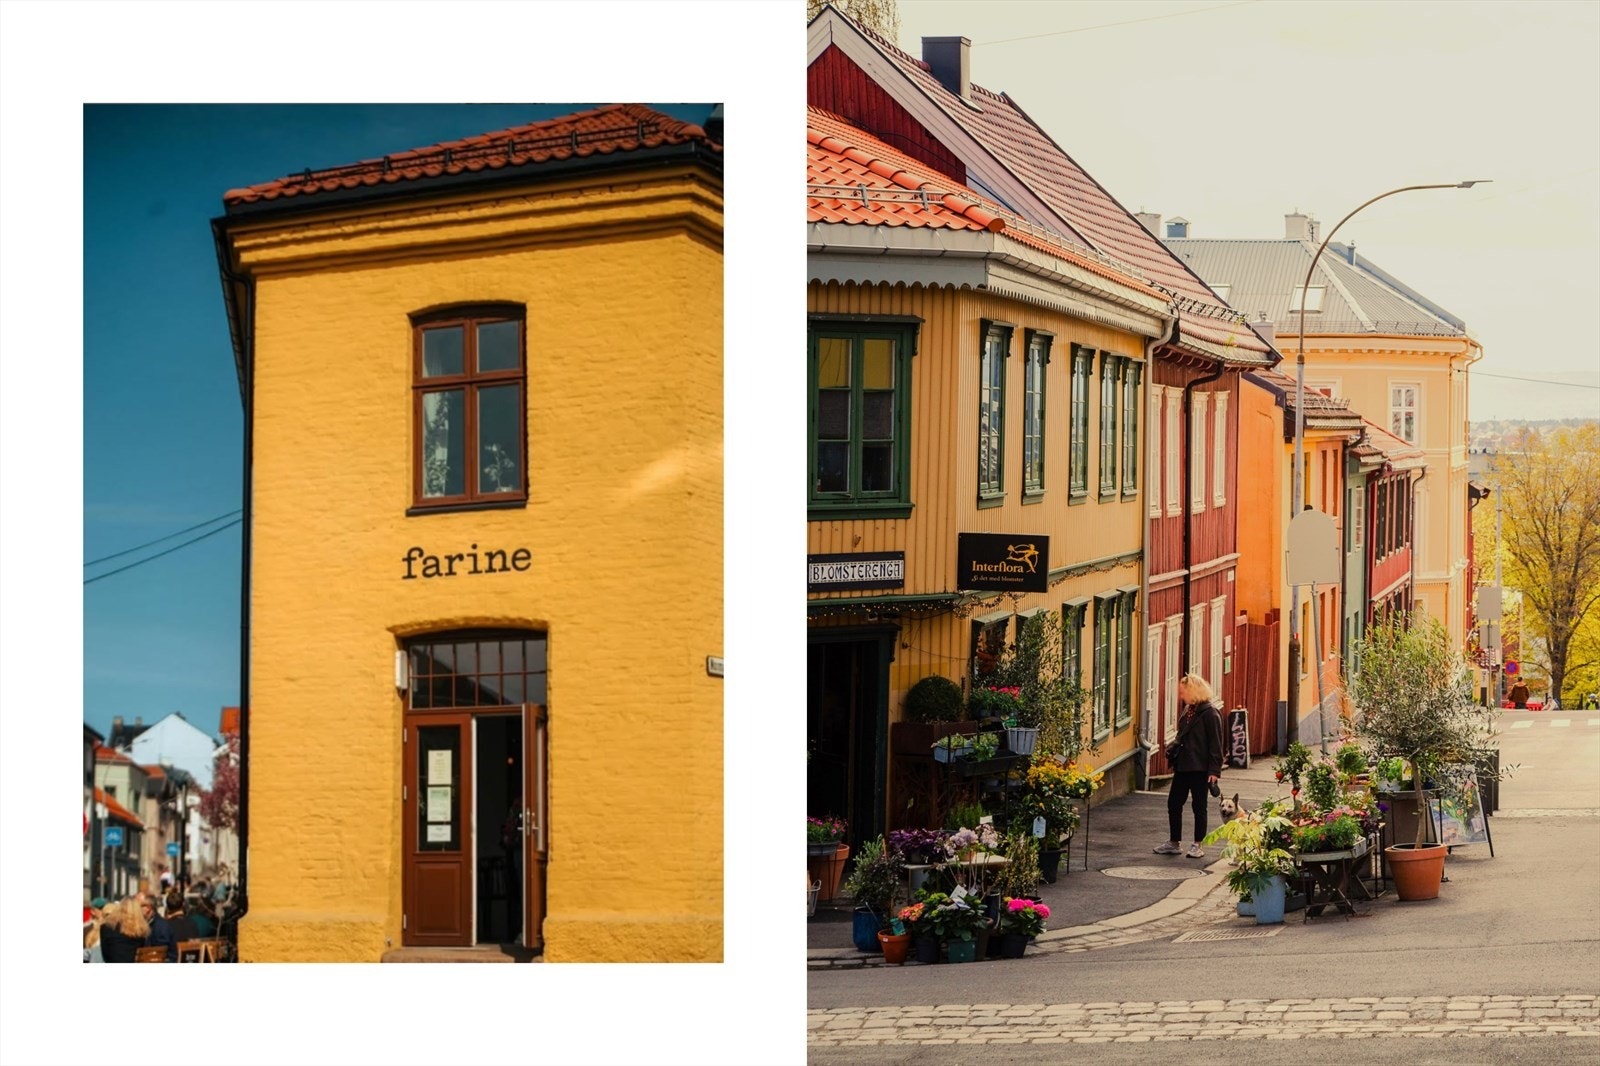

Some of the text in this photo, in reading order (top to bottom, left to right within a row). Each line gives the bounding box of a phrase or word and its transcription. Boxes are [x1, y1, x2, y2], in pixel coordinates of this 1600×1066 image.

[402, 543, 532, 580] farine
[972, 560, 1024, 573] Interflora
[812, 563, 901, 581] BLOMSTERENGA
